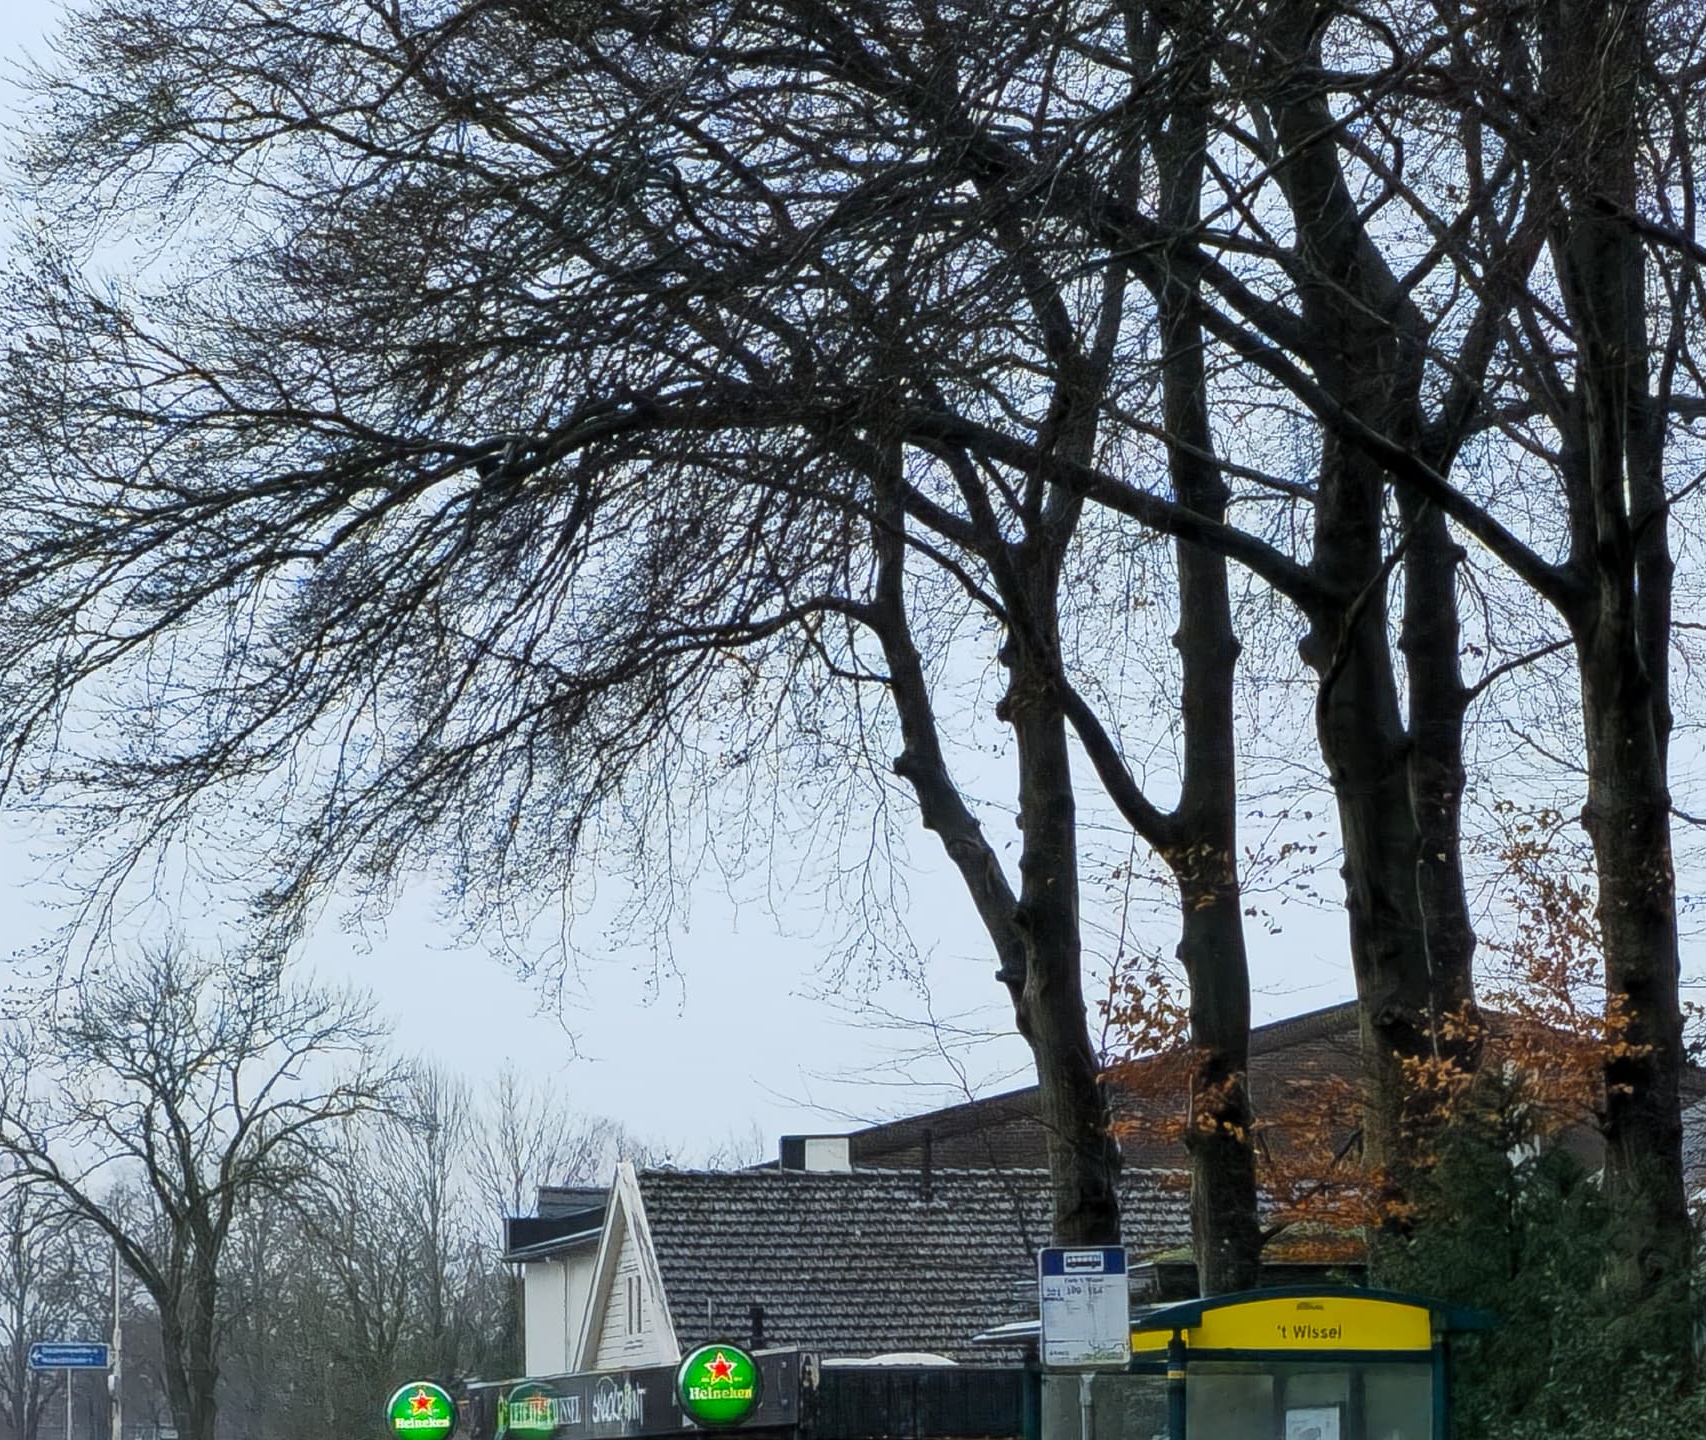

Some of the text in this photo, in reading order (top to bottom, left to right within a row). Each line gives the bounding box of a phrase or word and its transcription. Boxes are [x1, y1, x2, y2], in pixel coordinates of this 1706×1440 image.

[1276, 1323, 1342, 1340] 't Wissel
[689, 1387, 753, 1401] Heineken
[395, 1416, 451, 1430] Heineken
